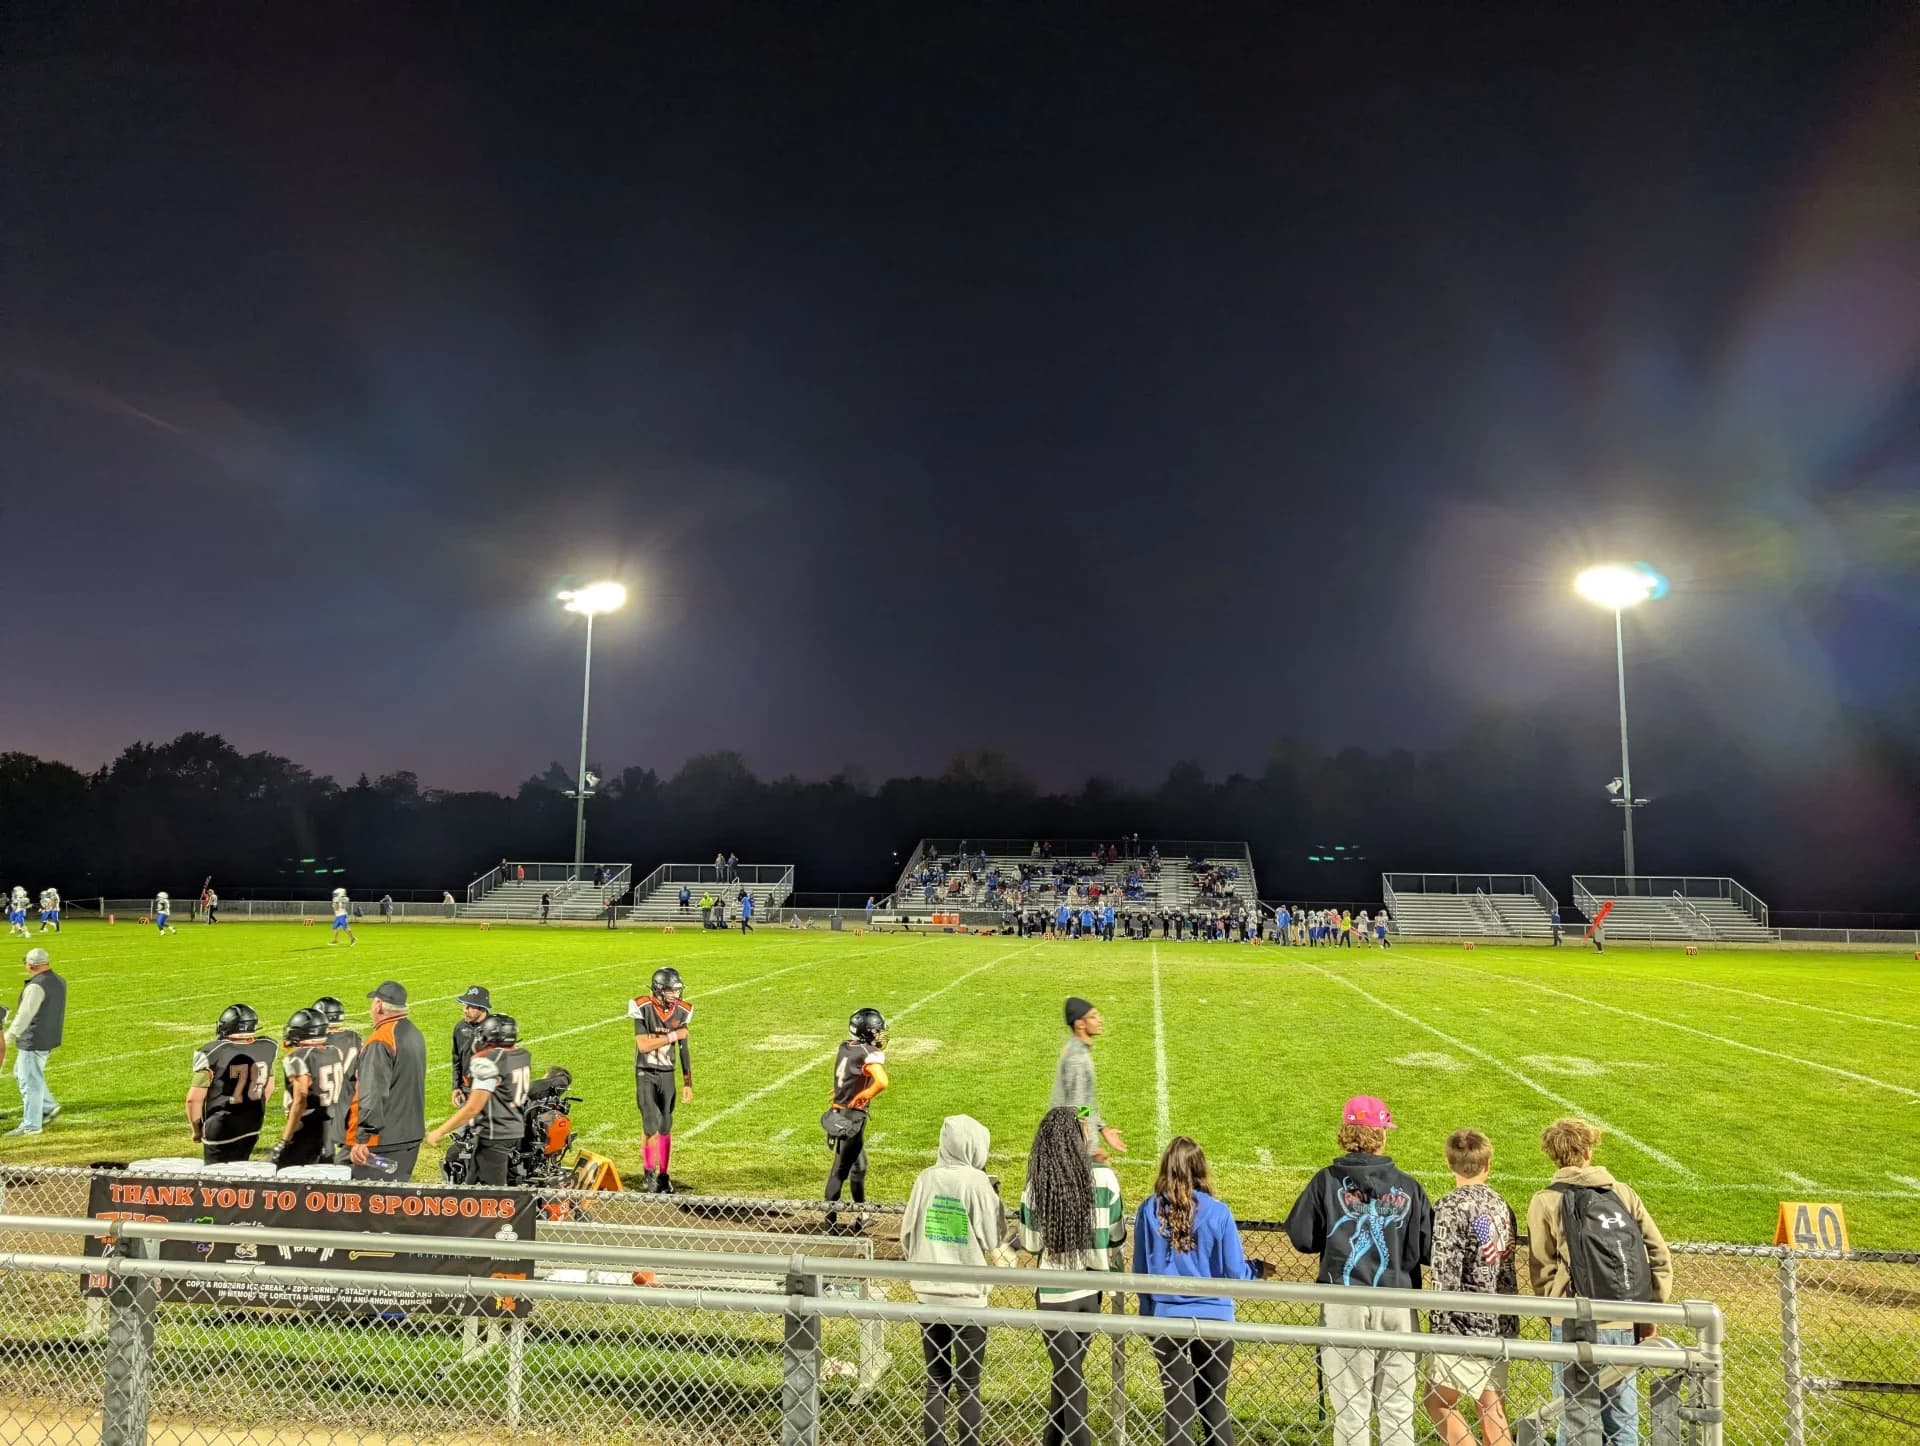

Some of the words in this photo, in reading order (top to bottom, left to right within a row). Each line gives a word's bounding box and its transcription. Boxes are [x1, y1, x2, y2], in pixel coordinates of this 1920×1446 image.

[229, 1061, 268, 1105] 78
[109, 1183, 194, 1206] THANK
[200, 1187, 255, 1209] YOU
[262, 1190, 297, 1212] TO
[305, 1192, 363, 1213] OUR
[369, 1195, 516, 1218] SPONSORS
[1794, 1204, 1843, 1252] 40
[269, 1292, 302, 1301] LORETTA
